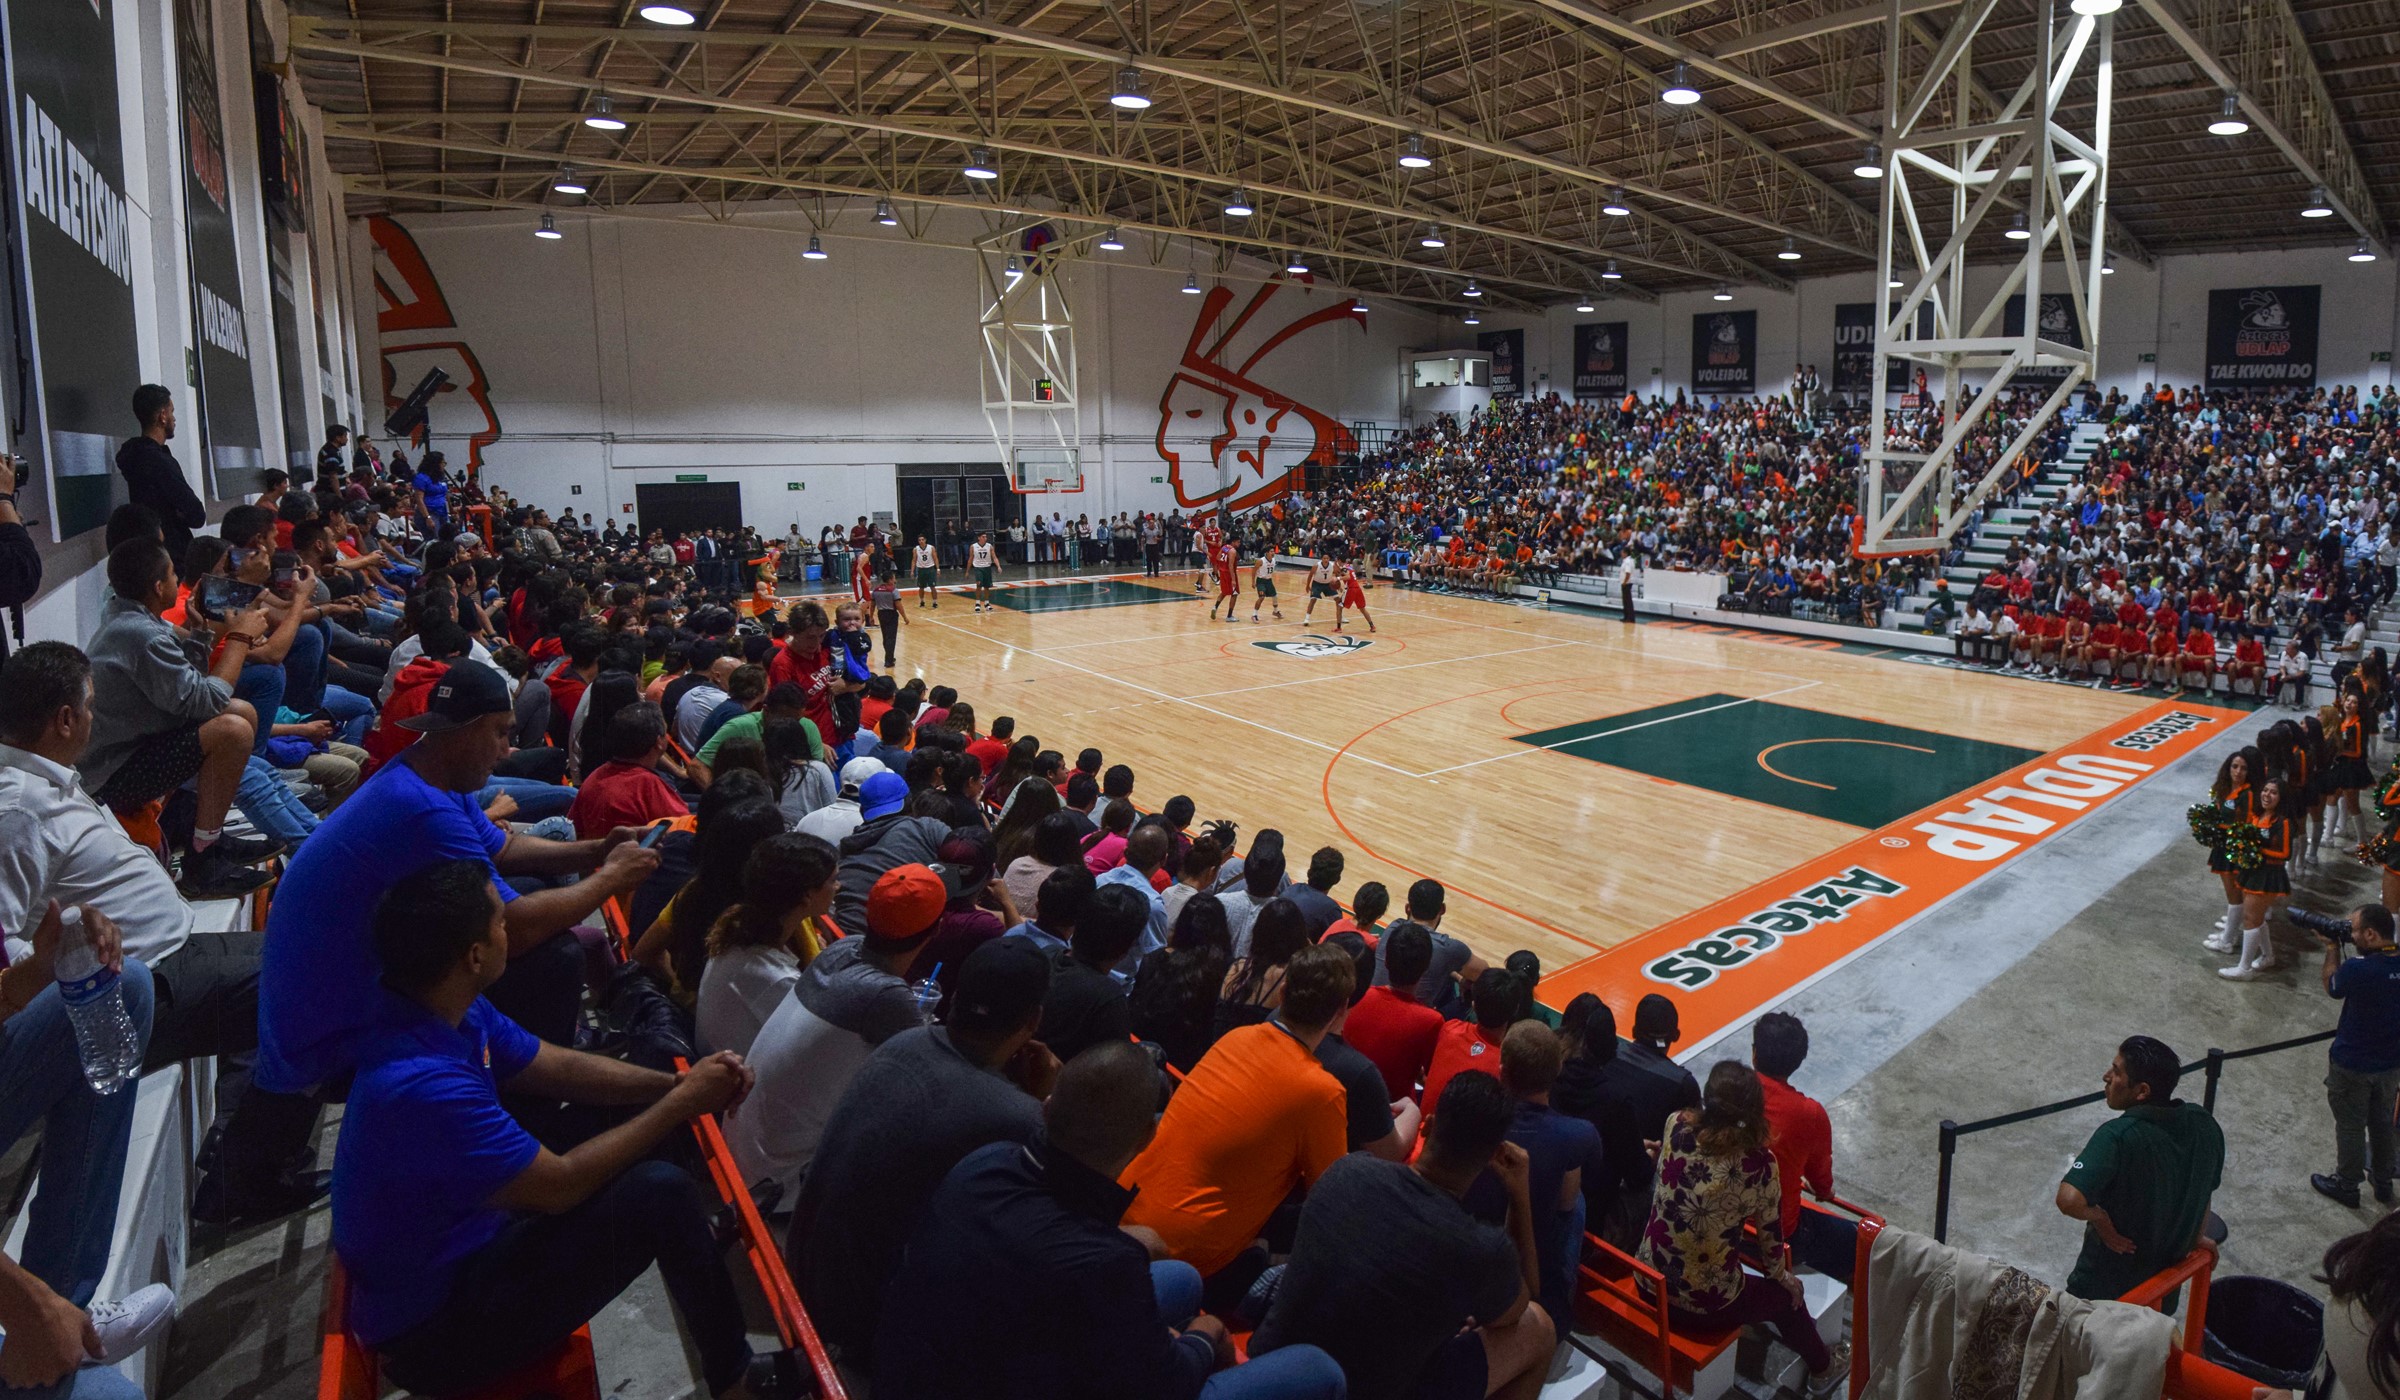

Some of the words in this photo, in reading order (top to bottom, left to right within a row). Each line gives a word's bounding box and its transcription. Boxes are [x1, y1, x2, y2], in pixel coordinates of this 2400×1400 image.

[26, 93, 132, 288] ATLETISMO
[200, 281, 248, 360] VOLEIBOL
[1835, 325, 1875, 345] UDL
[2238, 329, 2291, 342] Aztecas
[2236, 341, 2291, 356] UDLAP
[1697, 368, 1749, 382] VOLEIBOL
[2210, 364, 2237, 379] TAE
[2237, 363, 2287, 379] KWON
[2287, 363, 2313, 379] DO
[1575, 374, 1625, 388] ATLETISMO
[1044, 388, 1052, 400] 7
[978, 551, 988, 560] 17
[1220, 553, 1229, 563] 24
[1266, 566, 1274, 575] 13
[2109, 711, 2216, 752] Aztecas
[1914, 754, 2155, 862] UDLAP
[1641, 864, 1909, 992] Aztecas
